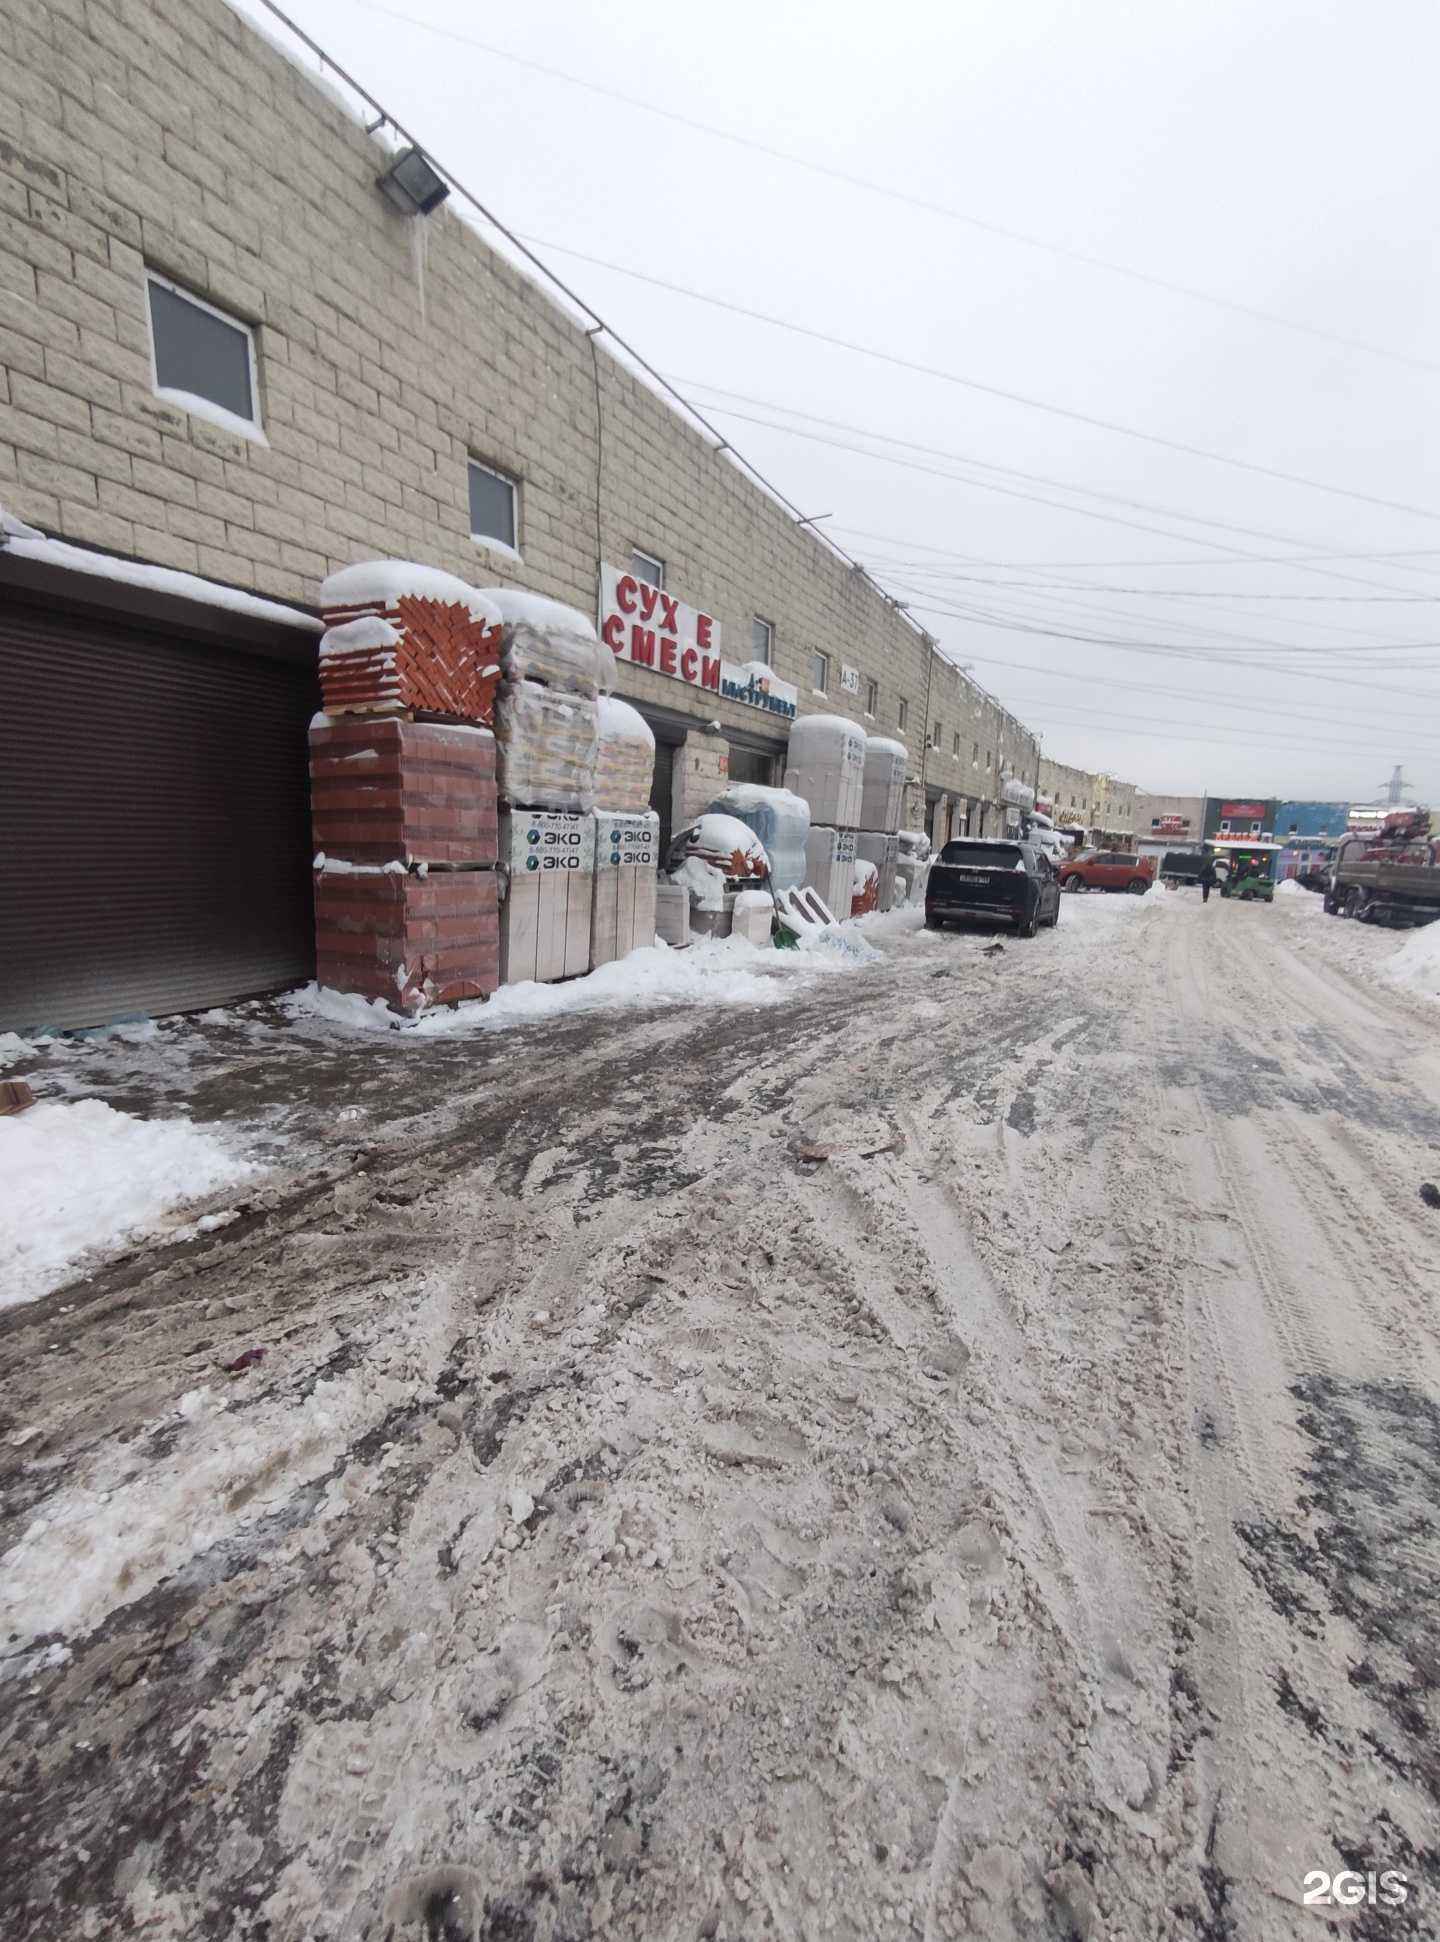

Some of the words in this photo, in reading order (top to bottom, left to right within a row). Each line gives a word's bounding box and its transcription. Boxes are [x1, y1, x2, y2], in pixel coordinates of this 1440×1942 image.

[602, 614, 720, 689] СМЕСИ
[545, 832, 580, 845] ЭКО
[624, 831, 651, 842] ЭКО
[543, 856, 579, 868] ЭКО
[623, 852, 650, 863] ЭКО
